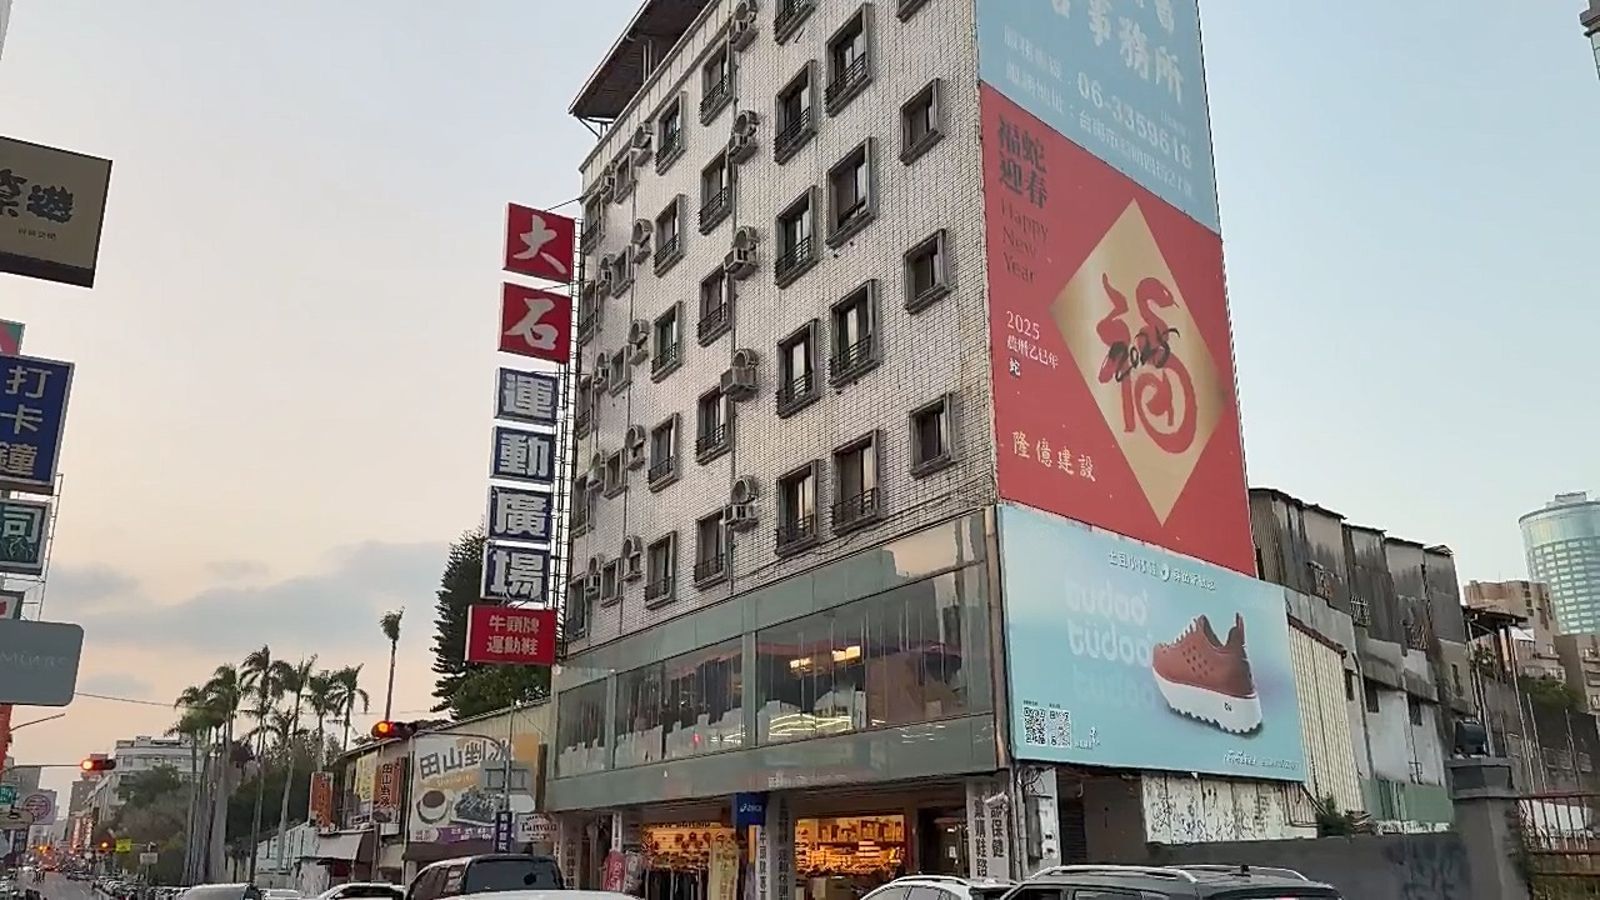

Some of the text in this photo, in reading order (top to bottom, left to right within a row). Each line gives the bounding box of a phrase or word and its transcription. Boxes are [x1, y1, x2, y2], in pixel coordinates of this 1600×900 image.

[1077, 71, 1193, 170] 06-3359618
[1001, 199, 1048, 240] Happy
[1003, 226, 1036, 258] New
[1003, 251, 1035, 283] Year
[1006, 310, 1041, 341] 2025
[1012, 430, 1096, 482] 隆億建設
[489, 614, 540, 634] 牛頭牌
[486, 635, 538, 656] 運動鞋
